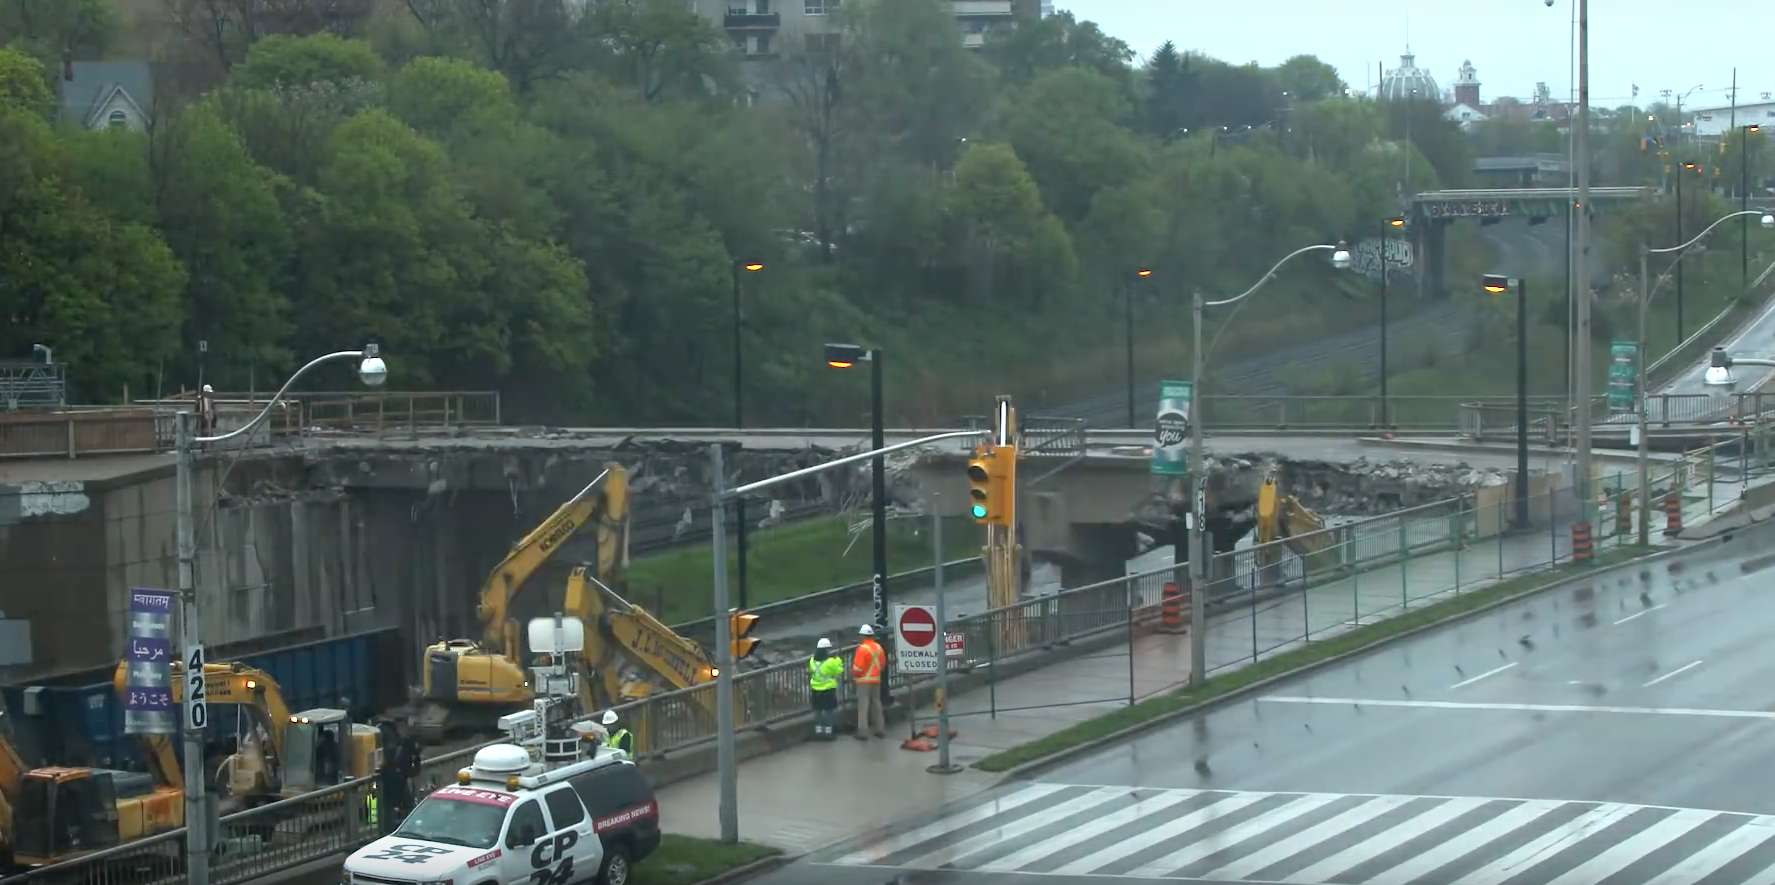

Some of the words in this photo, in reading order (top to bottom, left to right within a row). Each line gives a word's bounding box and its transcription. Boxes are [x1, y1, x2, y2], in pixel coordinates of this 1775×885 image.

[1160, 430, 1181, 446] you
[133, 640, 164, 660] مرحبا
[900, 650, 938, 658] SIDEWALK
[904, 660, 938, 668] CLOSED
[188, 648, 205, 727] 420
[129, 692, 169, 706] ようこそ
[437, 787, 477, 796] LIVE
[475, 791, 512, 803] EYE
[597, 812, 630, 830] BREAKING
[630, 804, 650, 819] NEWS!
[362, 850, 434, 865] 24
[389, 844, 455, 855] CP
[531, 830, 578, 869] CP
[530, 855, 575, 885] 24
